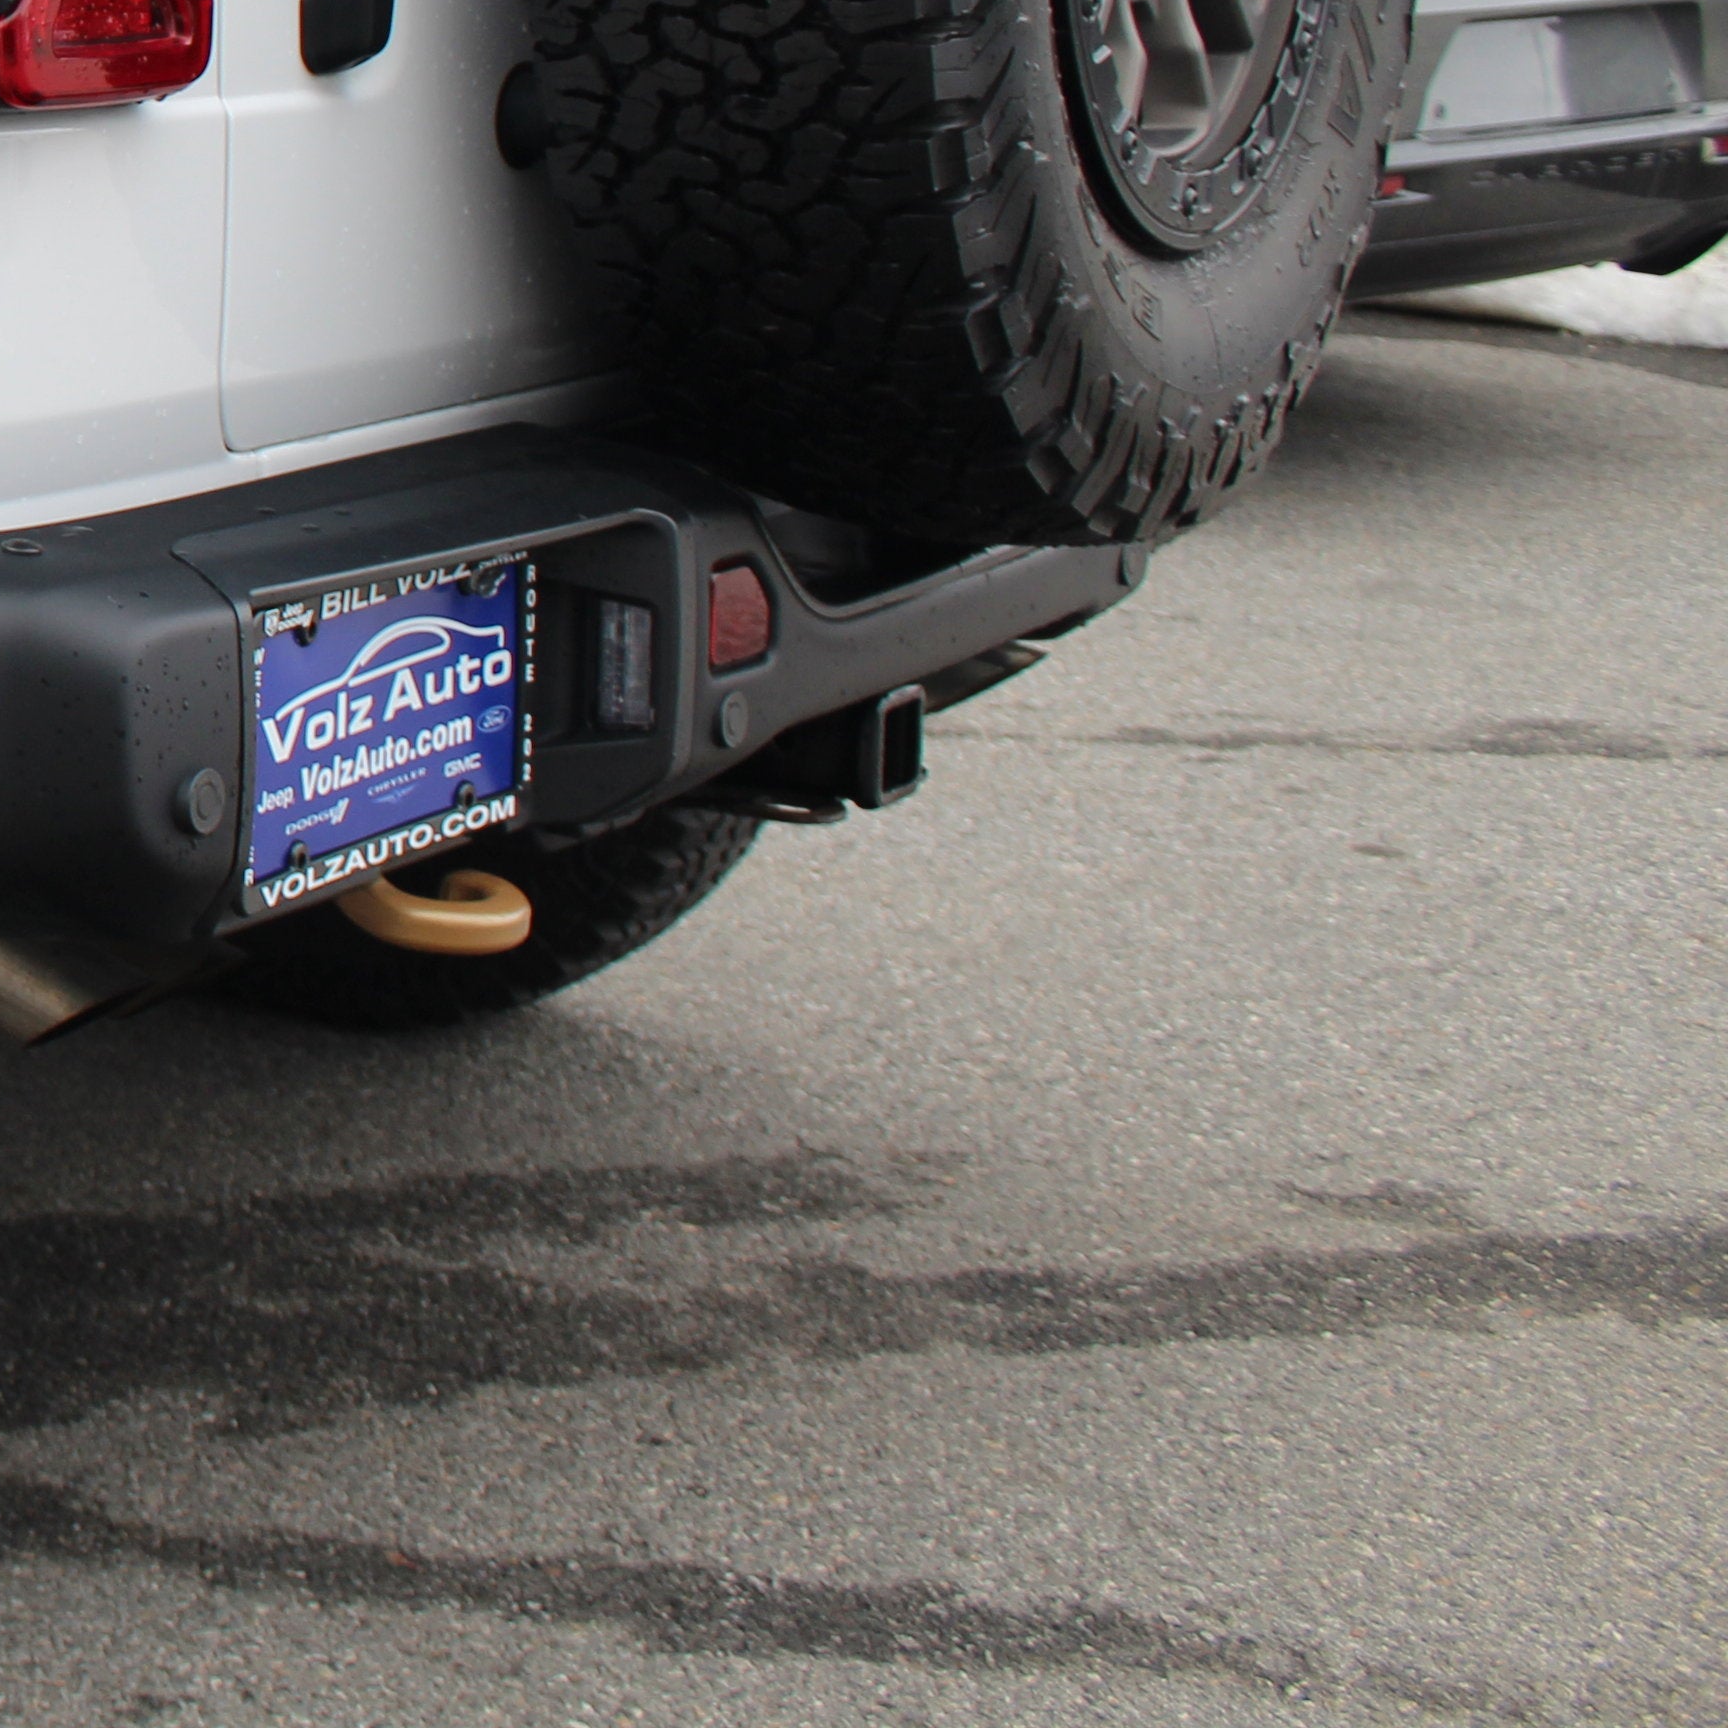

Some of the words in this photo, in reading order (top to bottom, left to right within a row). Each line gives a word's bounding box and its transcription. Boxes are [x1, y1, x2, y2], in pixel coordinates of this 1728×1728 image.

[321, 583, 387, 619] BILL
[525, 564, 536, 683] ROUTE
[262, 691, 374, 763] Volz
[383, 649, 513, 722] Auto
[257, 786, 294, 814] Jeep
[301, 716, 472, 801] VolzAuto.com
[367, 768, 427, 796] CHRYSLER
[261, 794, 517, 908] VOLZAUTO.COM
